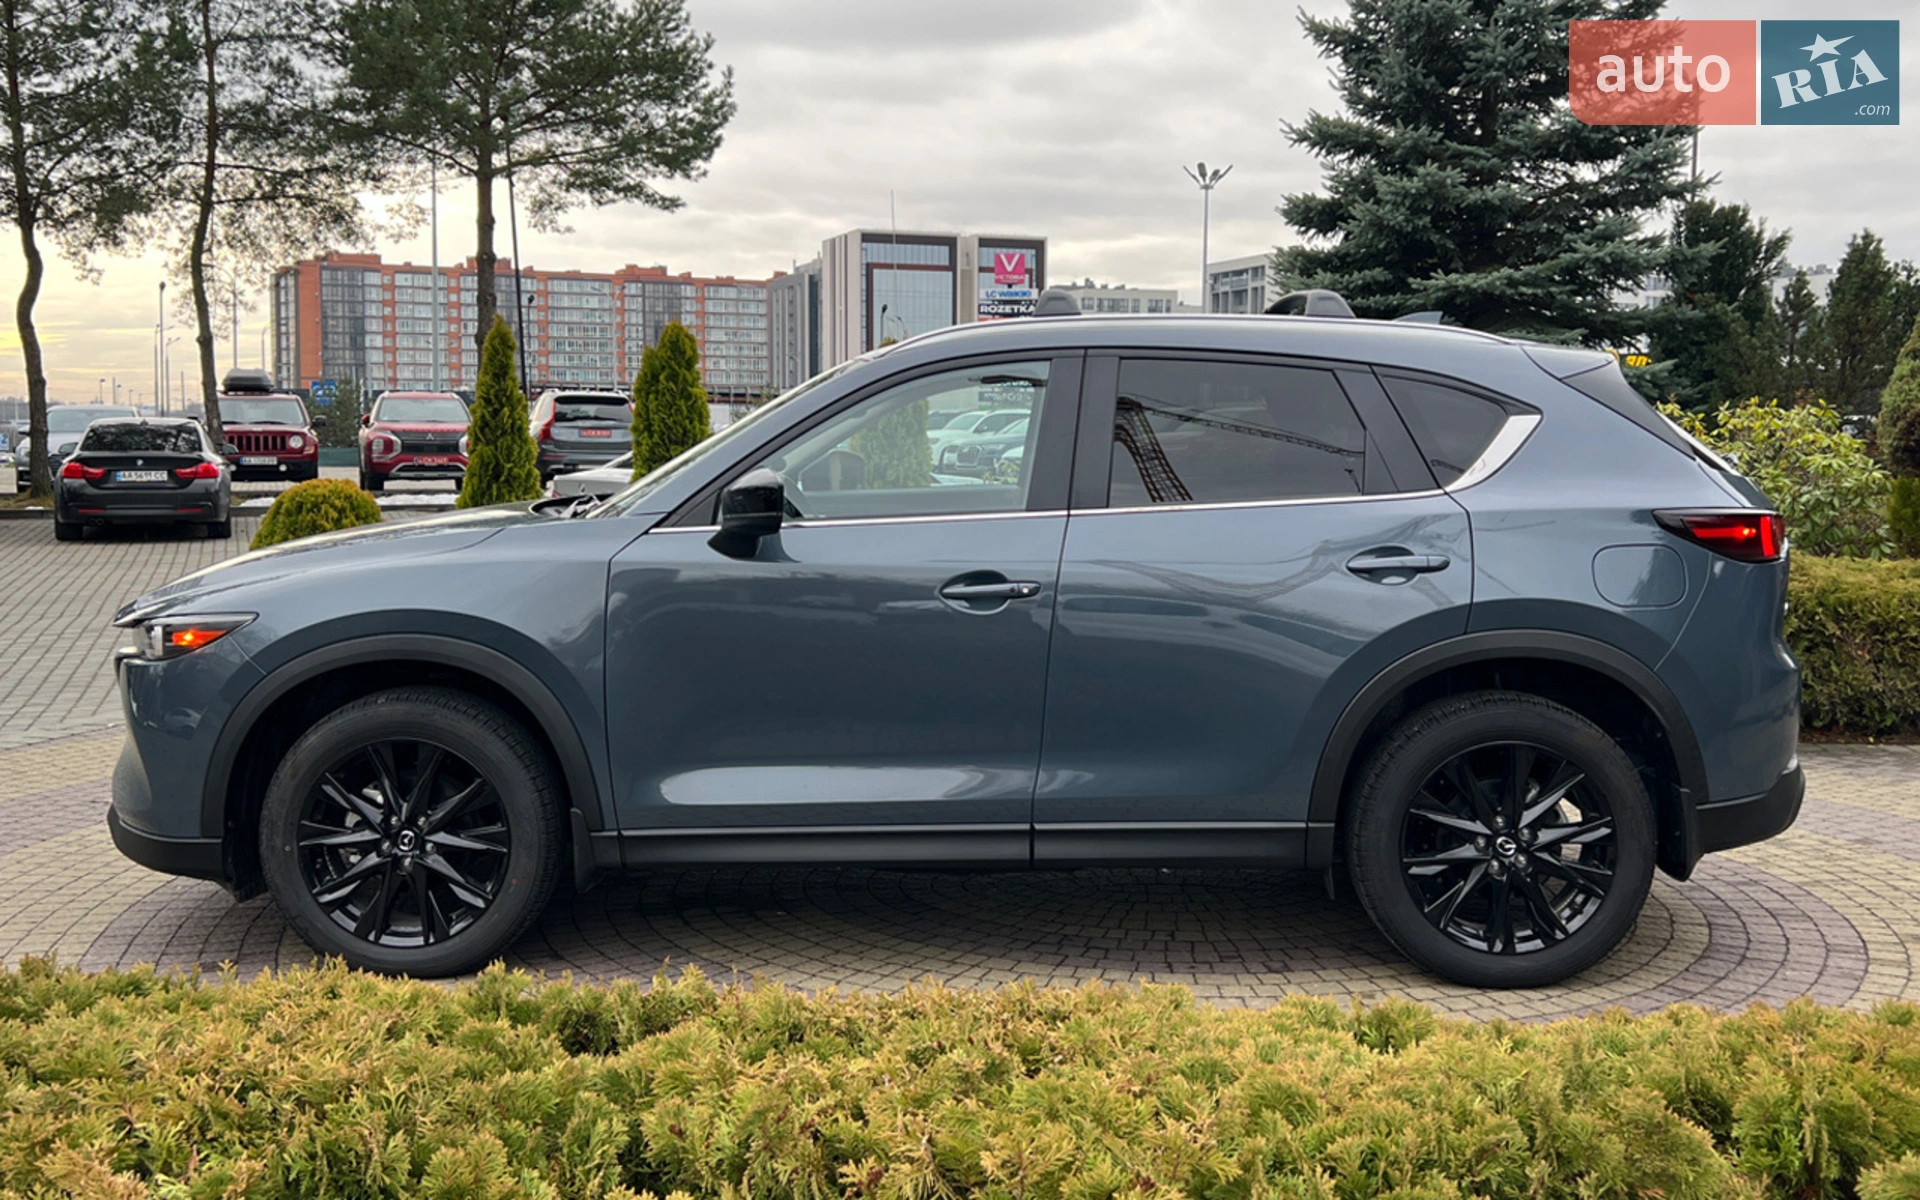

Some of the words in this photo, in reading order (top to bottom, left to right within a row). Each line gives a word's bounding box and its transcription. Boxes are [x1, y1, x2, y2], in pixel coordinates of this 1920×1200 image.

[999, 253, 1021, 272] V
[985, 290, 997, 298] LC
[980, 305, 1036, 313] ROZETKA
[122, 471, 133, 479] AA
[153, 471, 166, 479] CC
